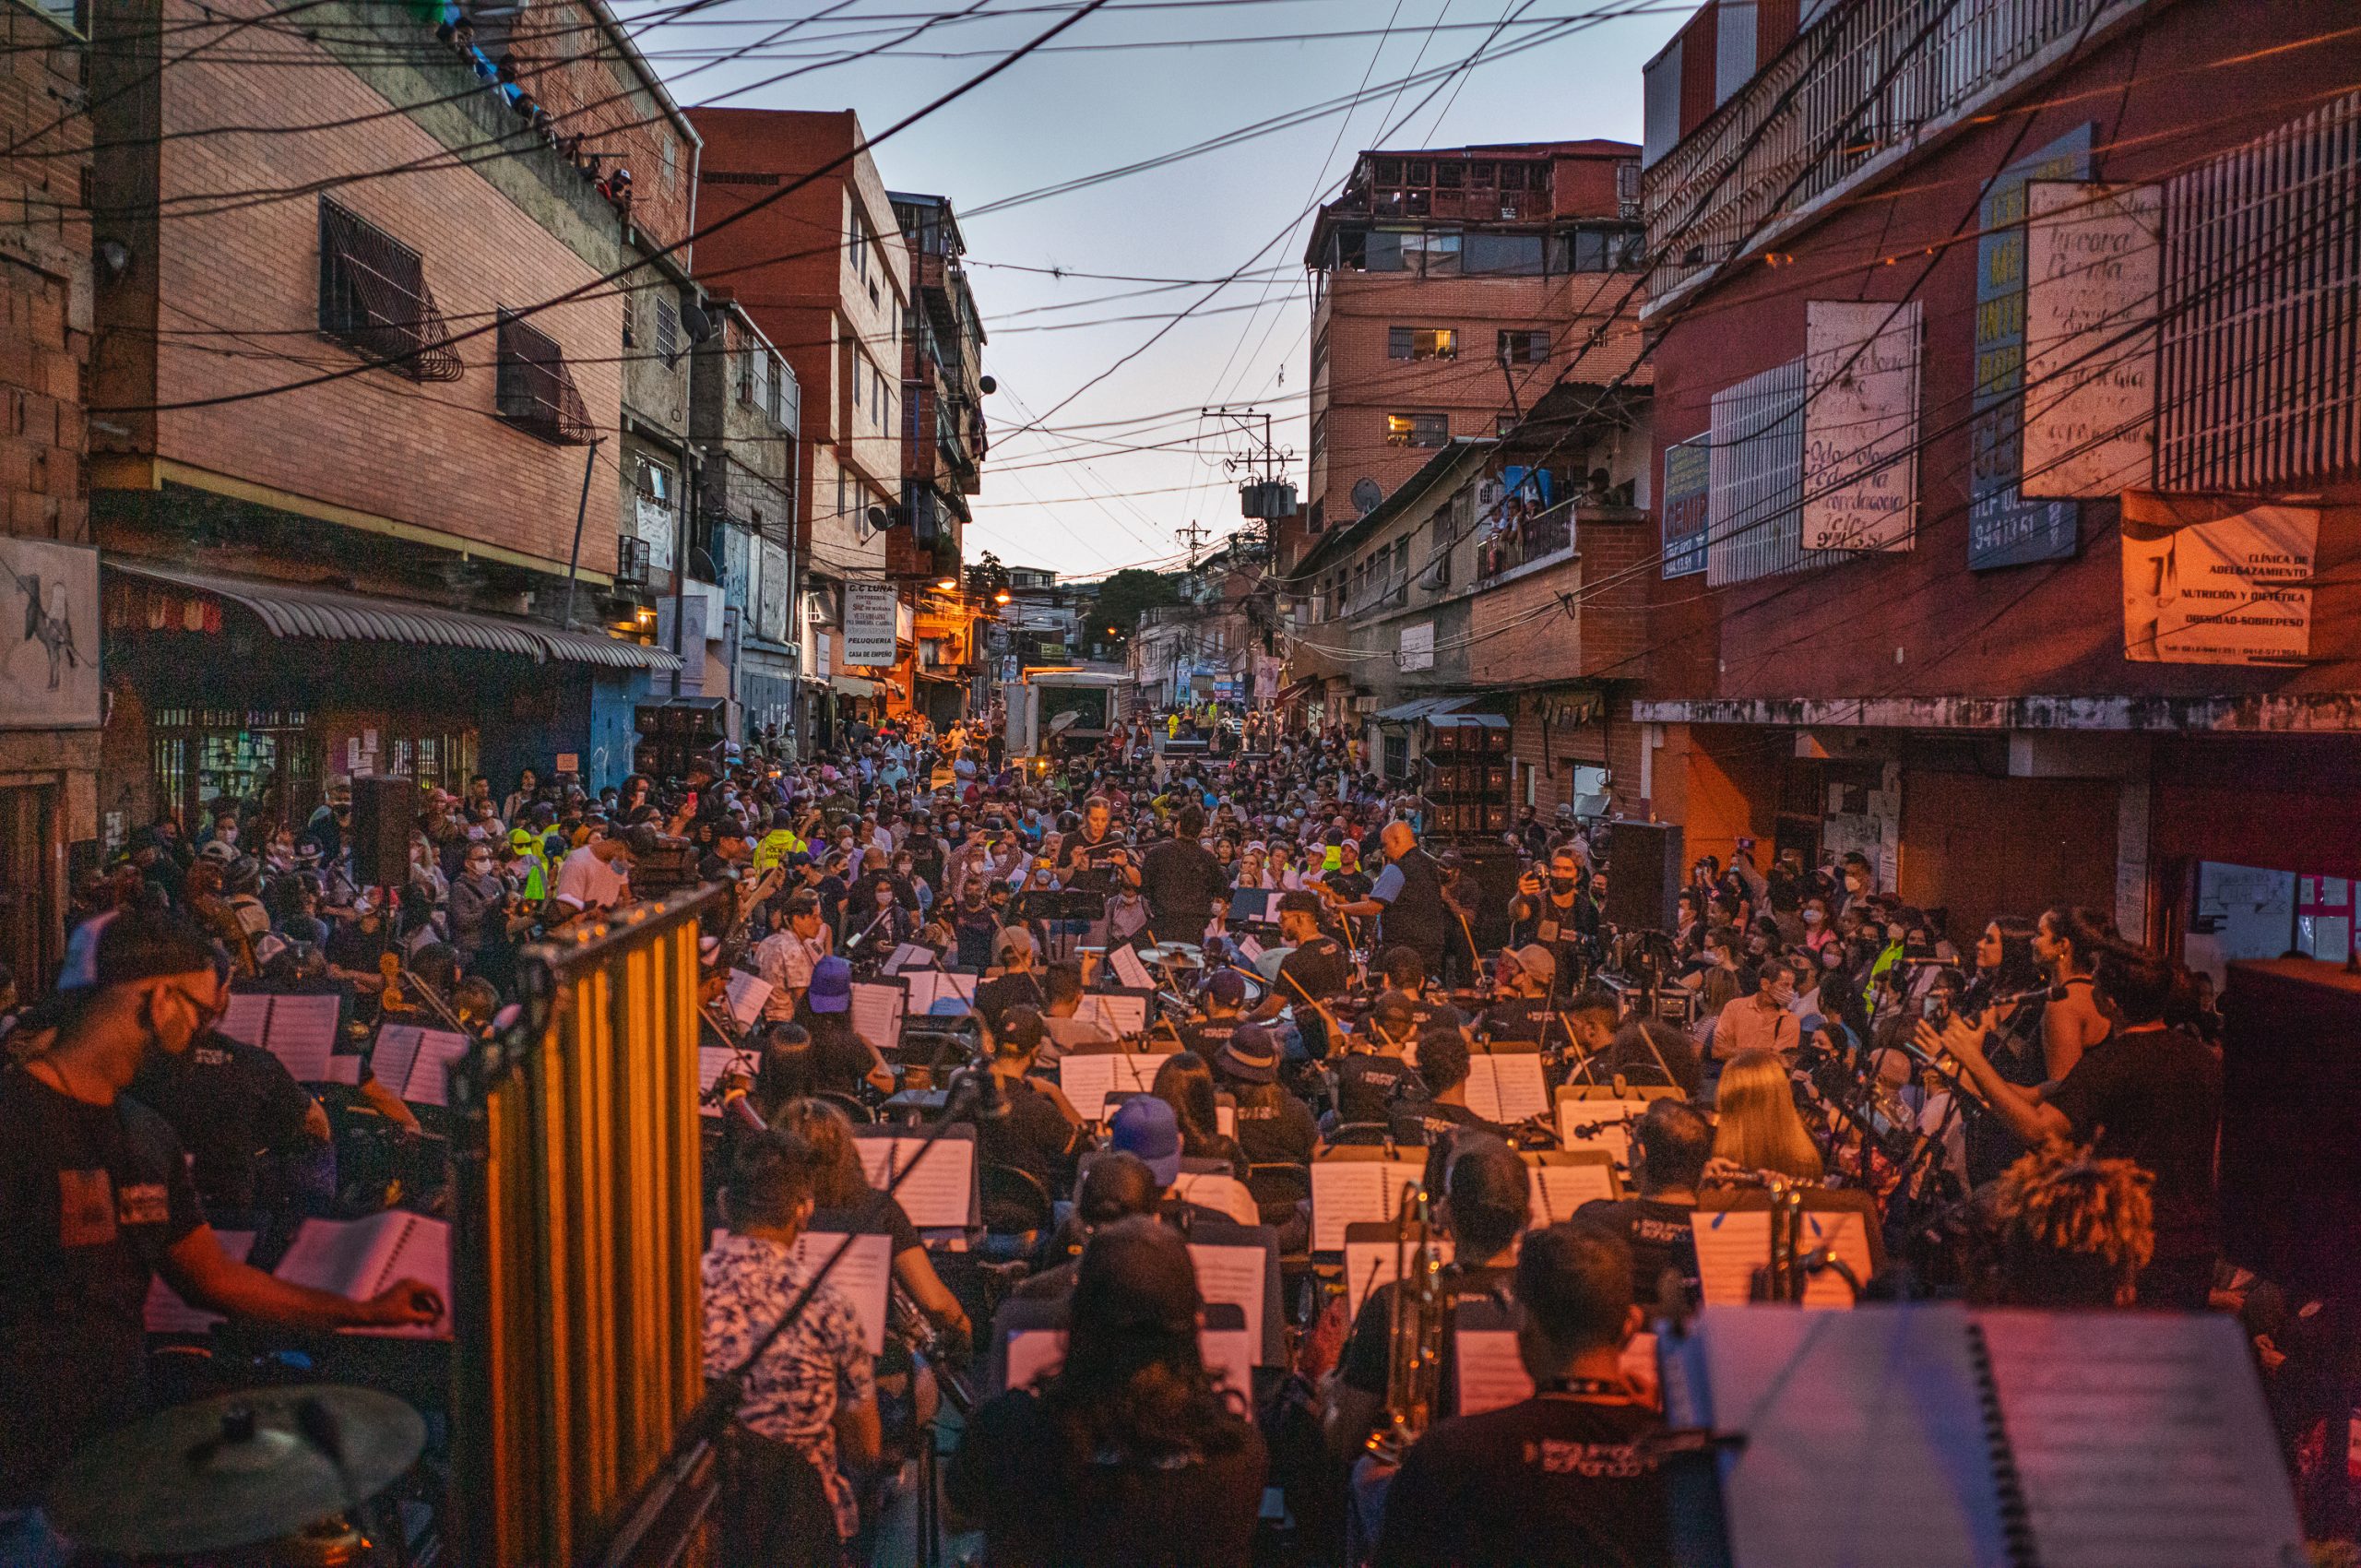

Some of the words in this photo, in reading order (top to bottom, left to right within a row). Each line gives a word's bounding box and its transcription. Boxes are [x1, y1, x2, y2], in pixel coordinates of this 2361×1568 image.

[2248, 552, 2291, 564] CLÍNICA
[2295, 556, 2309, 564] DE
[2210, 565, 2308, 577] ADELGAZAMIENTO
[2181, 588, 2237, 600] NUTRICIÓN
[2240, 591, 2248, 600] Y
